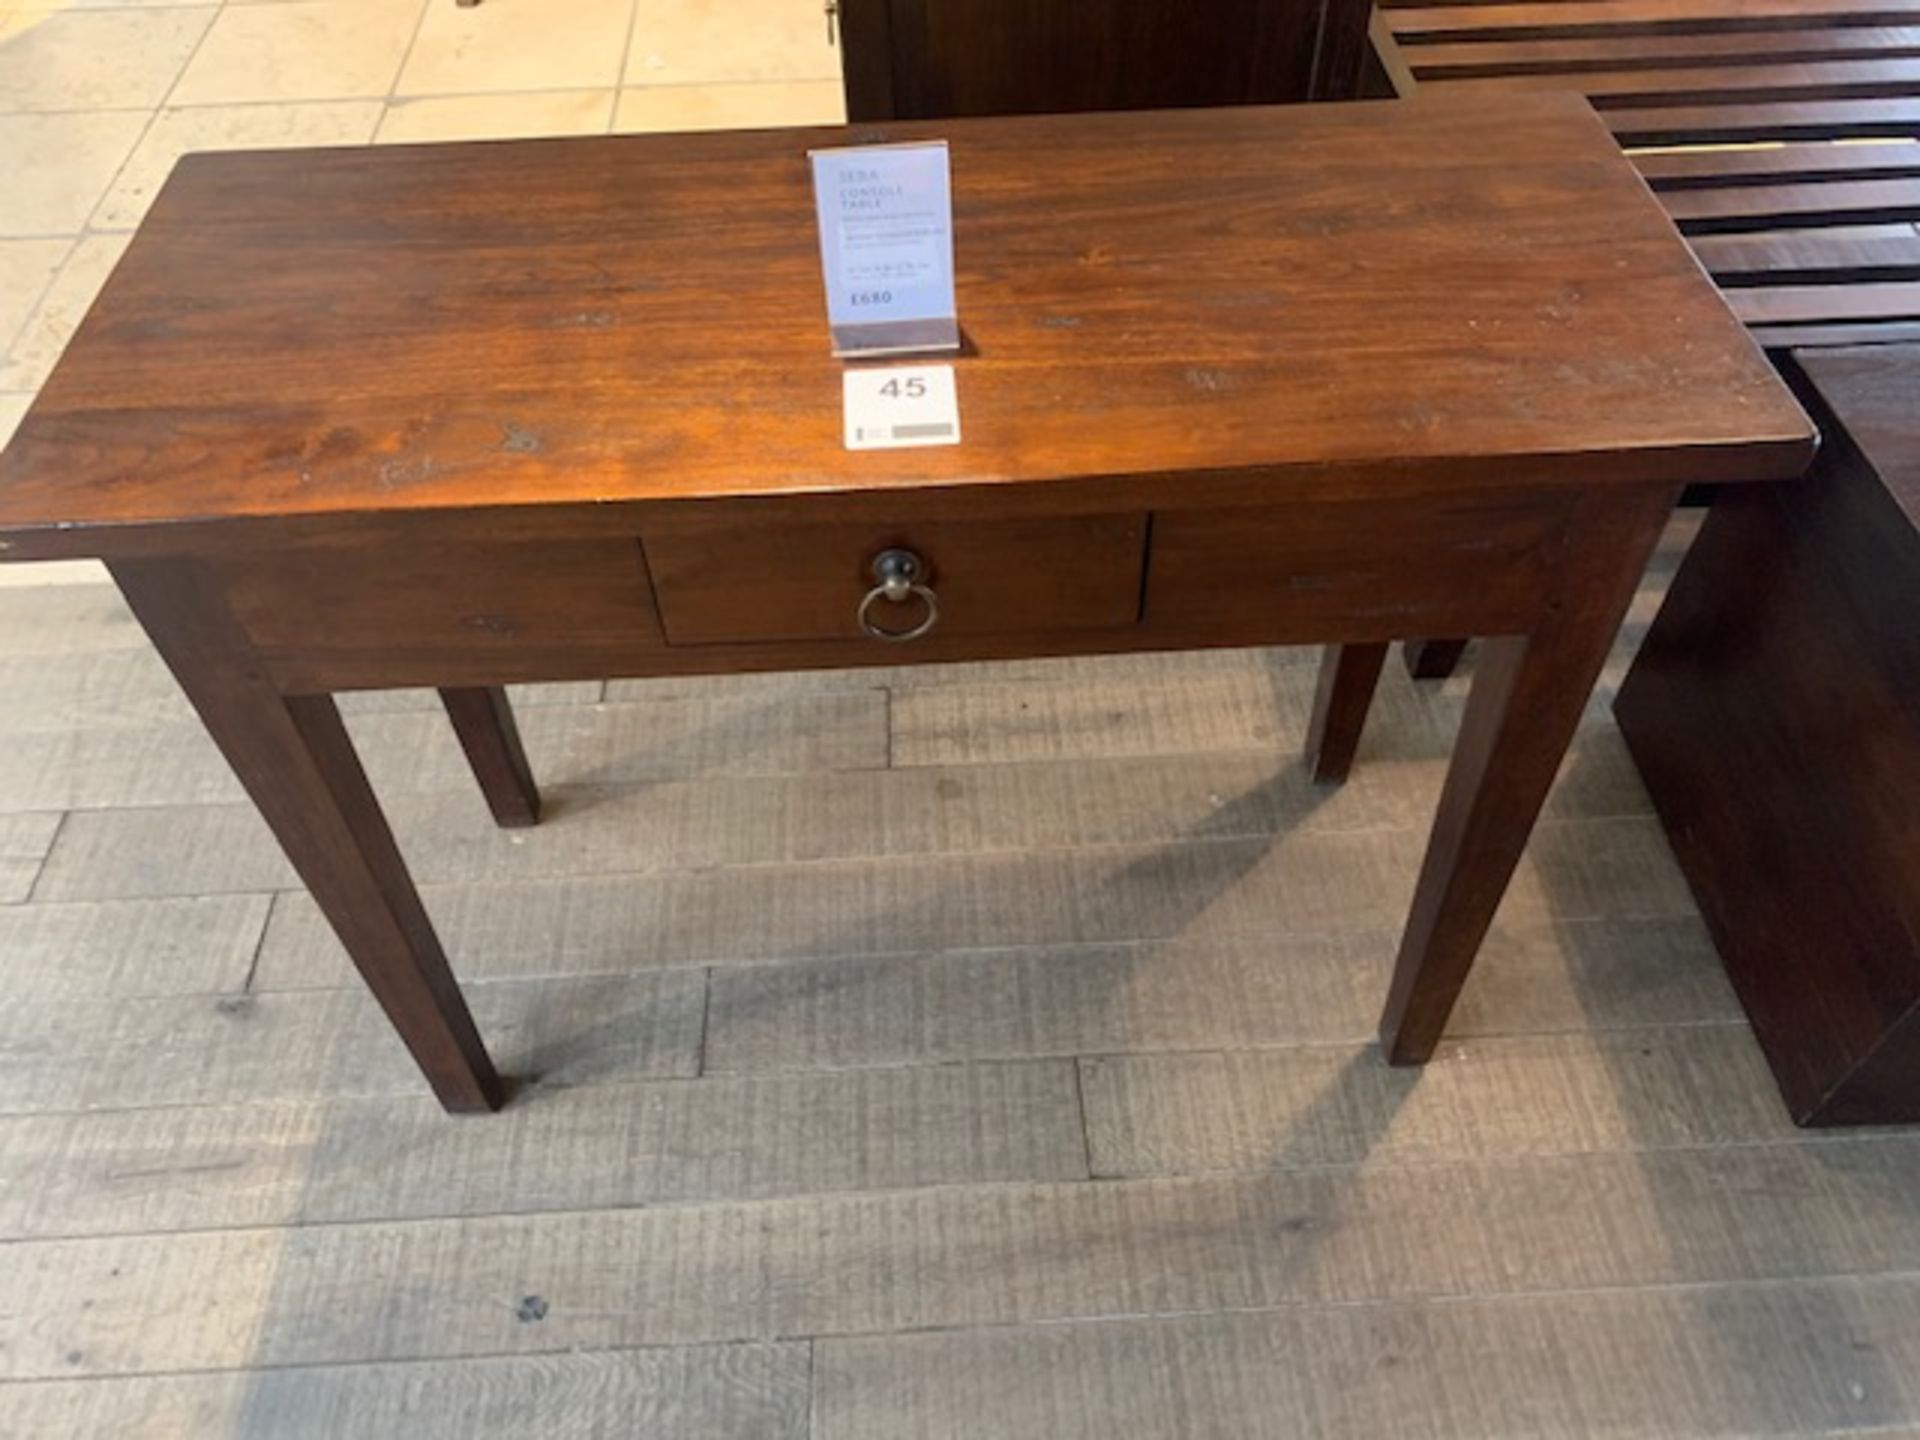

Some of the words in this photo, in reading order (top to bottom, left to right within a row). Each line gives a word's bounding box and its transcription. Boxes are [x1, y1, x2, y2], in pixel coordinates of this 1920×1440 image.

[841, 199, 882, 210] TABLE
[850, 290, 893, 307] £680
[879, 377, 927, 399] 45
